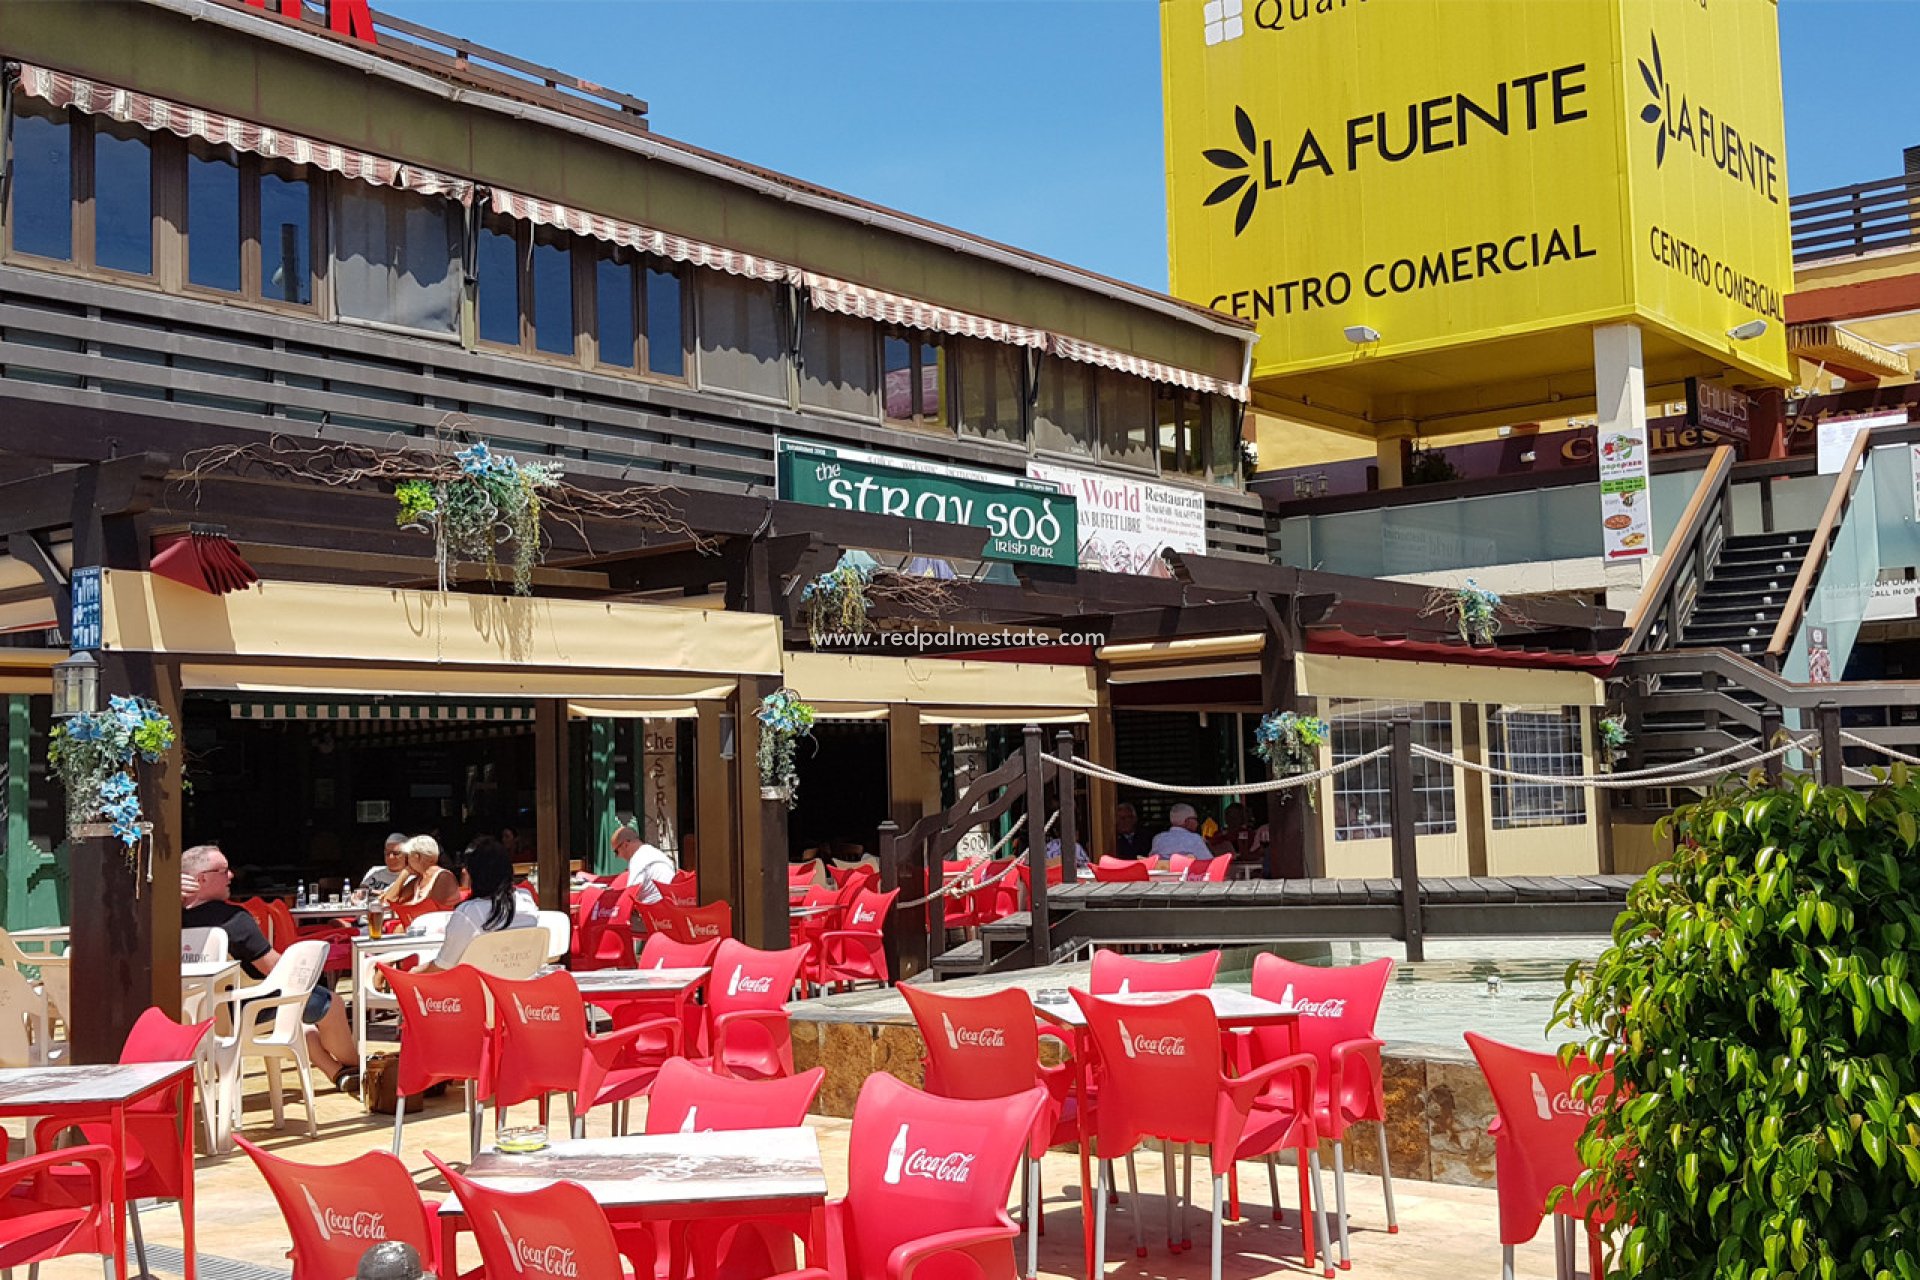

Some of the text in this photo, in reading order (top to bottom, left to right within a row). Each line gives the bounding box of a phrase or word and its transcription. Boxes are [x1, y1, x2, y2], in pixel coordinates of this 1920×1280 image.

[1263, 63, 1588, 191] LA FUENTE
[1664, 83, 1779, 204] LA FUENTE
[1364, 224, 1597, 298] COMERCIAL
[1650, 225, 1784, 323] CENTRO COMERCIAL
[815, 462, 841, 481] the
[1081, 478, 1141, 513] World
[1145, 485, 1203, 510] Restaurant
